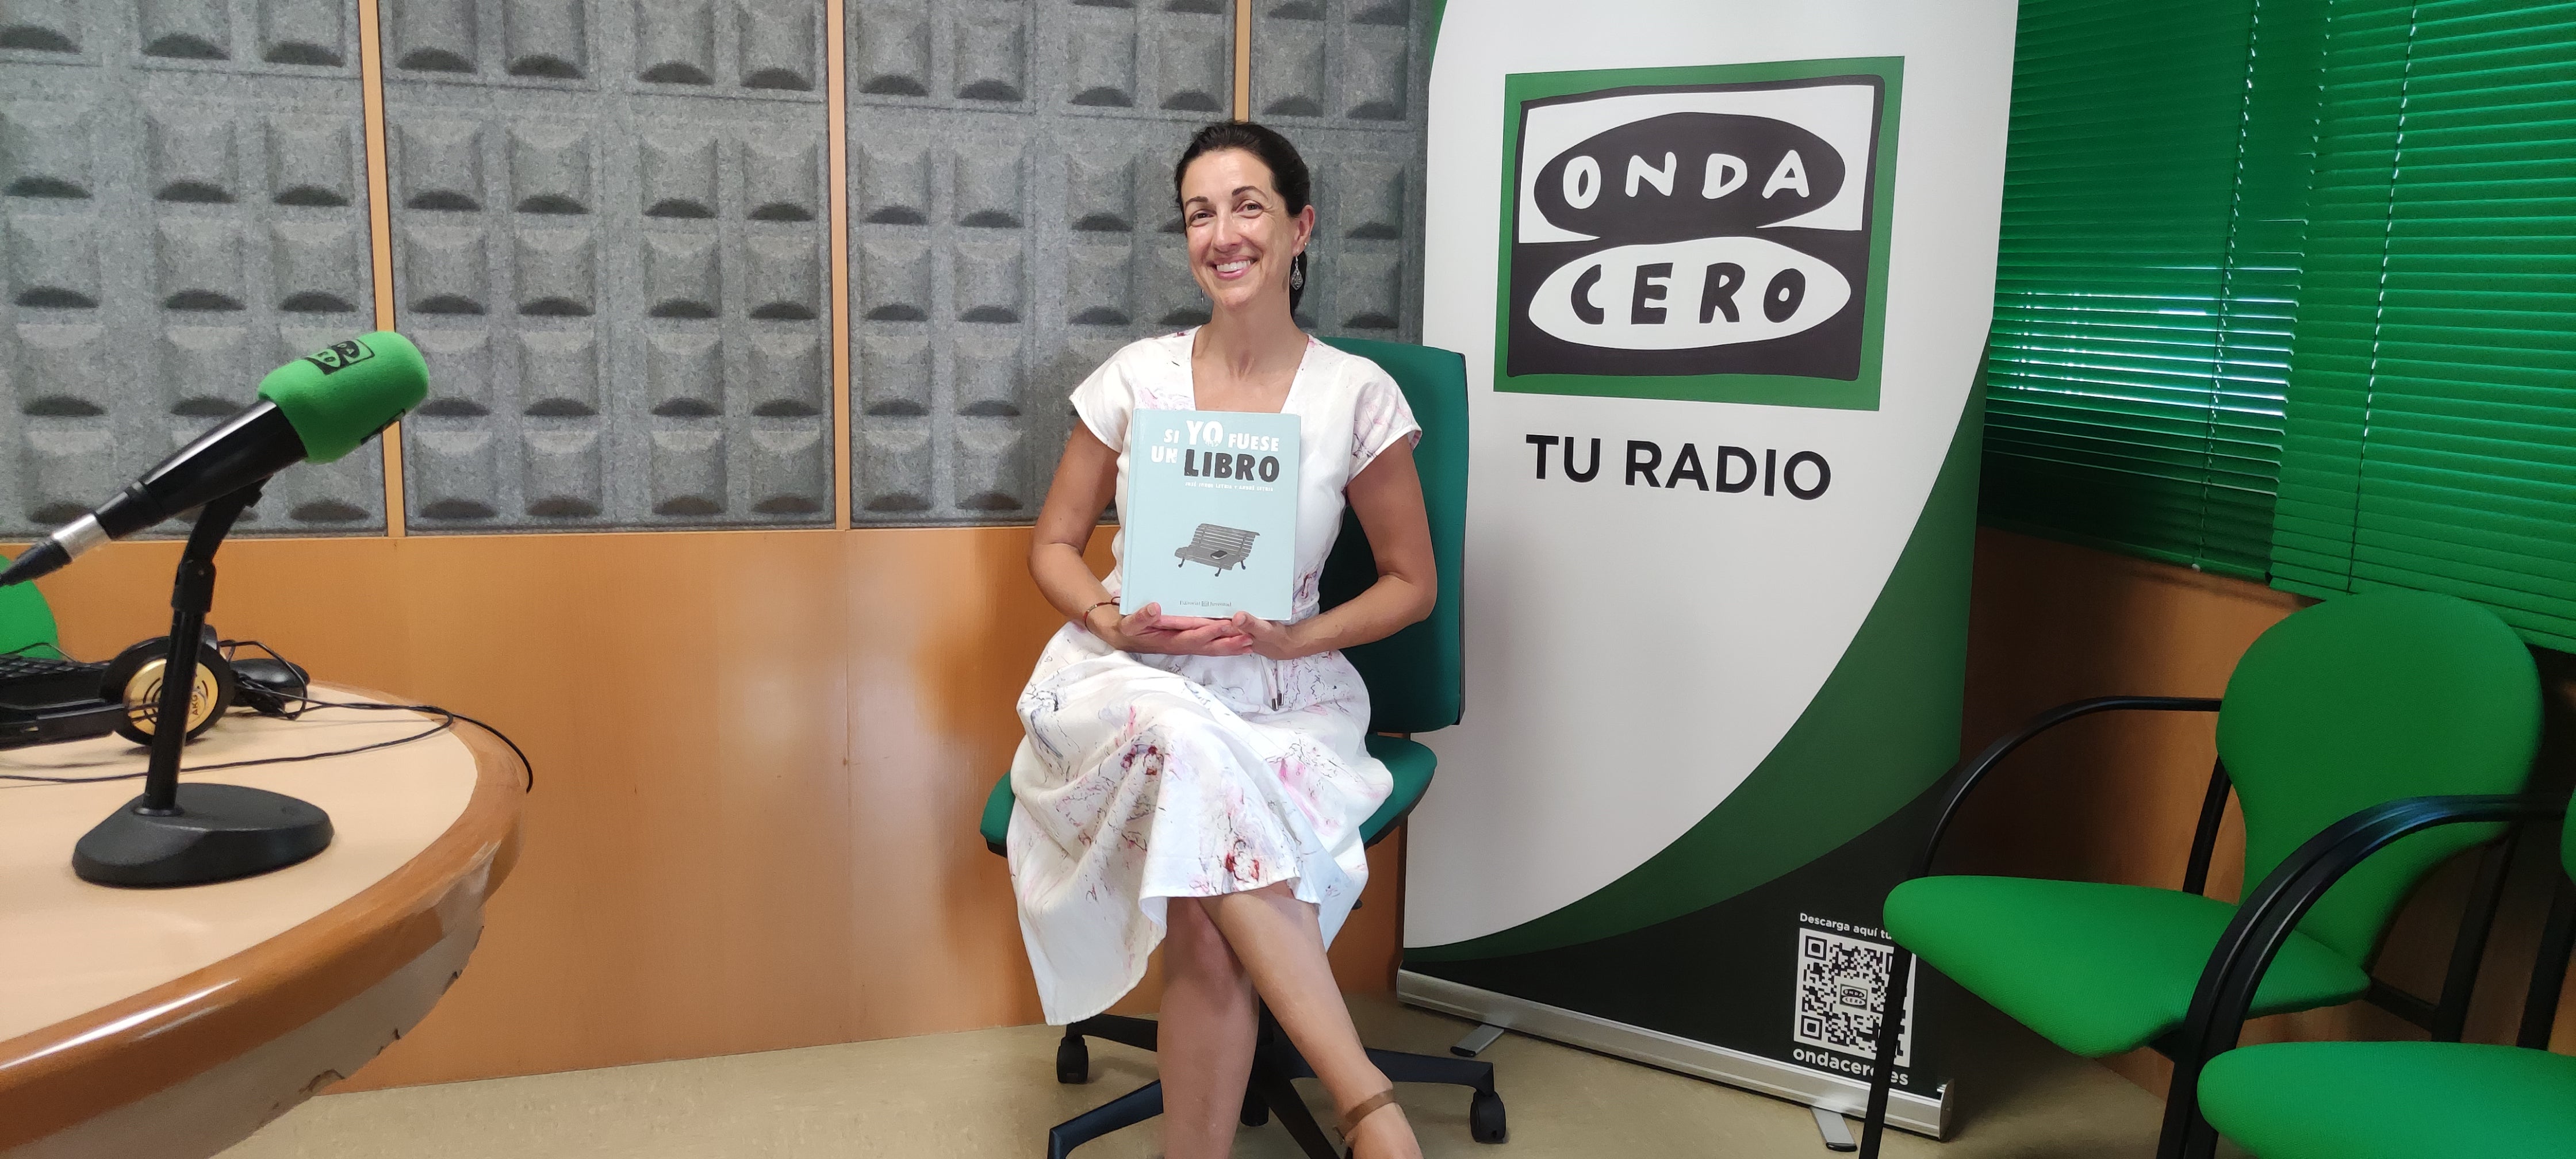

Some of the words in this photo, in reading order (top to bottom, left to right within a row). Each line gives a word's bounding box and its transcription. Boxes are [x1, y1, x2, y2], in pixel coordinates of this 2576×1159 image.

[1562, 149, 1810, 210] ONDA
[1570, 262, 1805, 325] CERO
[1163, 428, 1180, 444] SI
[1186, 420, 1224, 447] YO
[1228, 432, 1279, 452] FUESE
[1151, 446, 1178, 463] UN
[1184, 448, 1280, 482] LIBRO
[1525, 433, 1601, 483] TU
[1625, 439, 1831, 501] RADIO
[1800, 912, 1850, 931] Descarga
[1853, 925, 1877, 937] aquí
[1793, 1048, 1908, 1086] ondaceres
